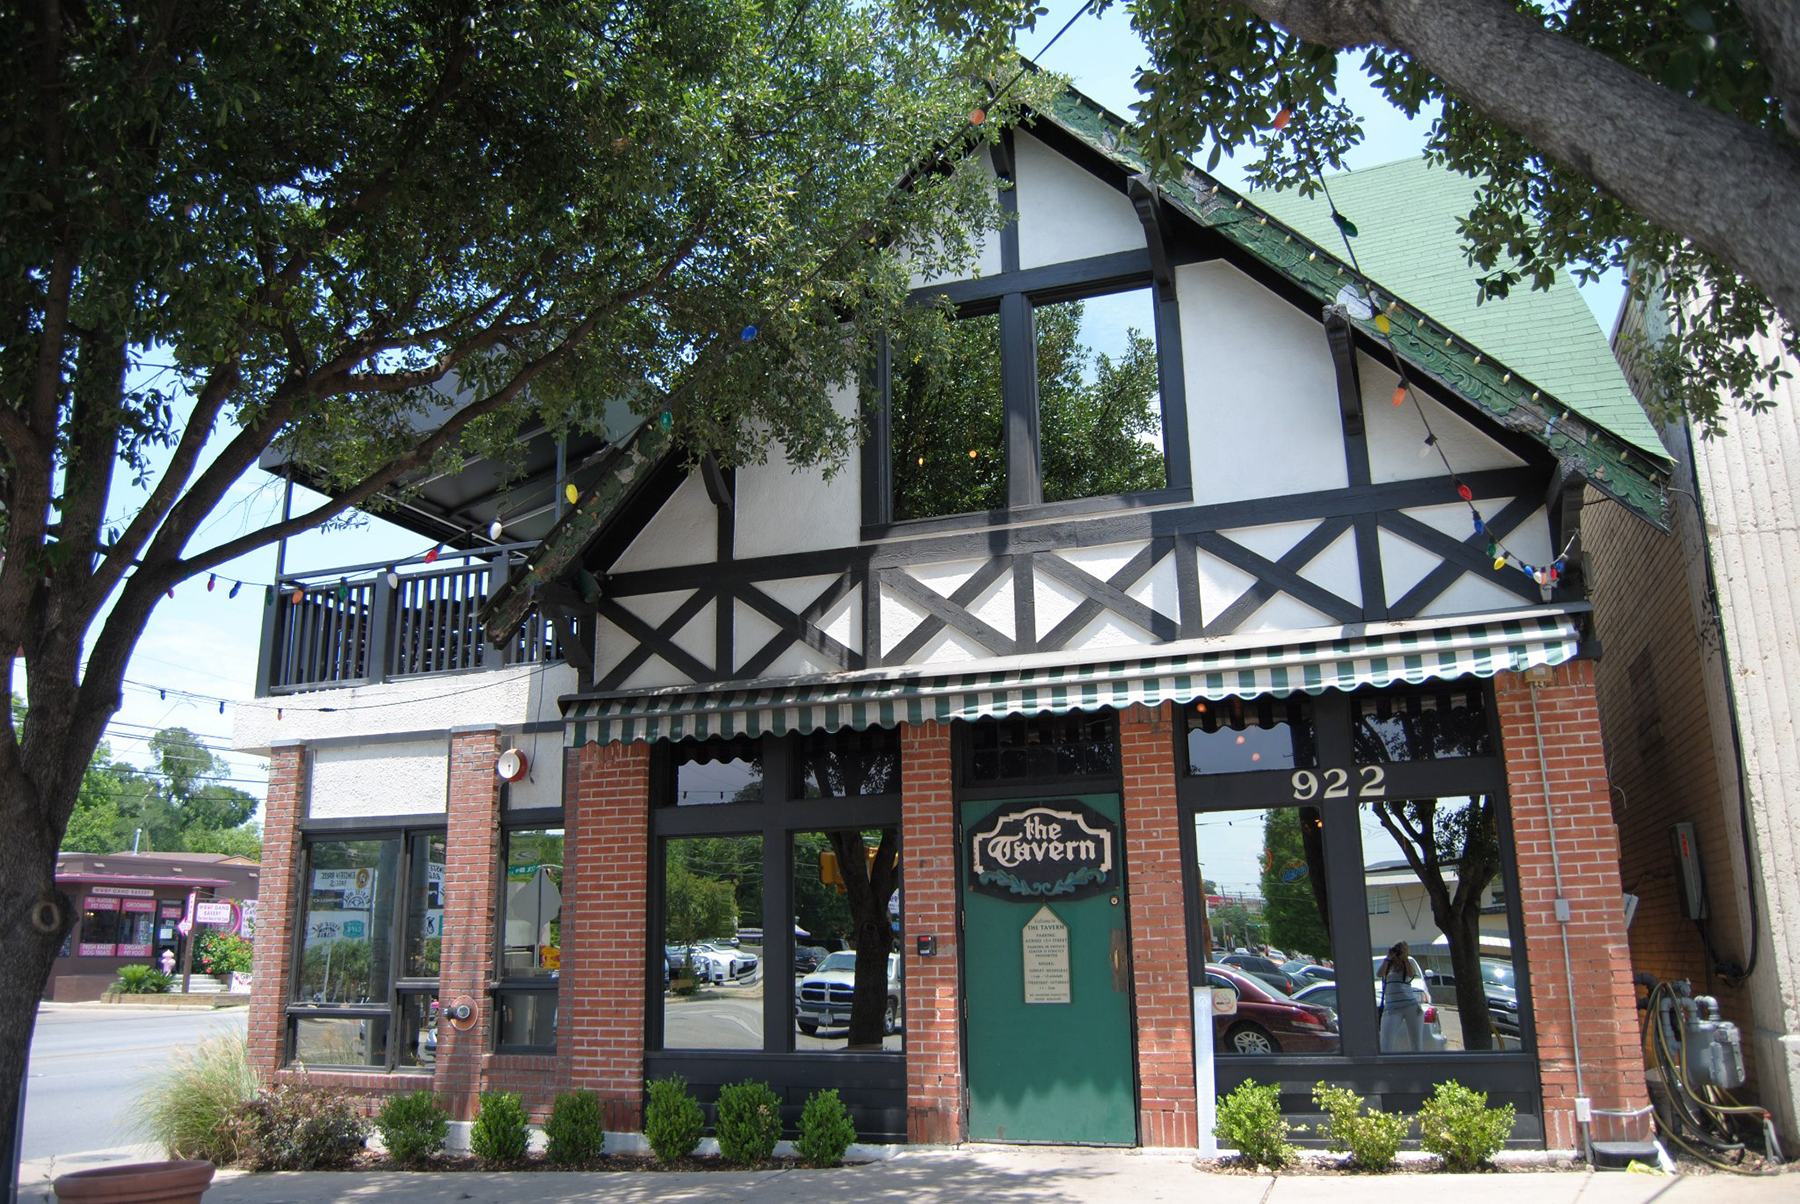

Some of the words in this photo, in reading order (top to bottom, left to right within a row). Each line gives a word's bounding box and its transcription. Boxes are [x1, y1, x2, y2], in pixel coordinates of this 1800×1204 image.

[1291, 766, 1386, 800] 922
[1024, 815, 1062, 840] the
[987, 832, 1096, 867] Tavern
